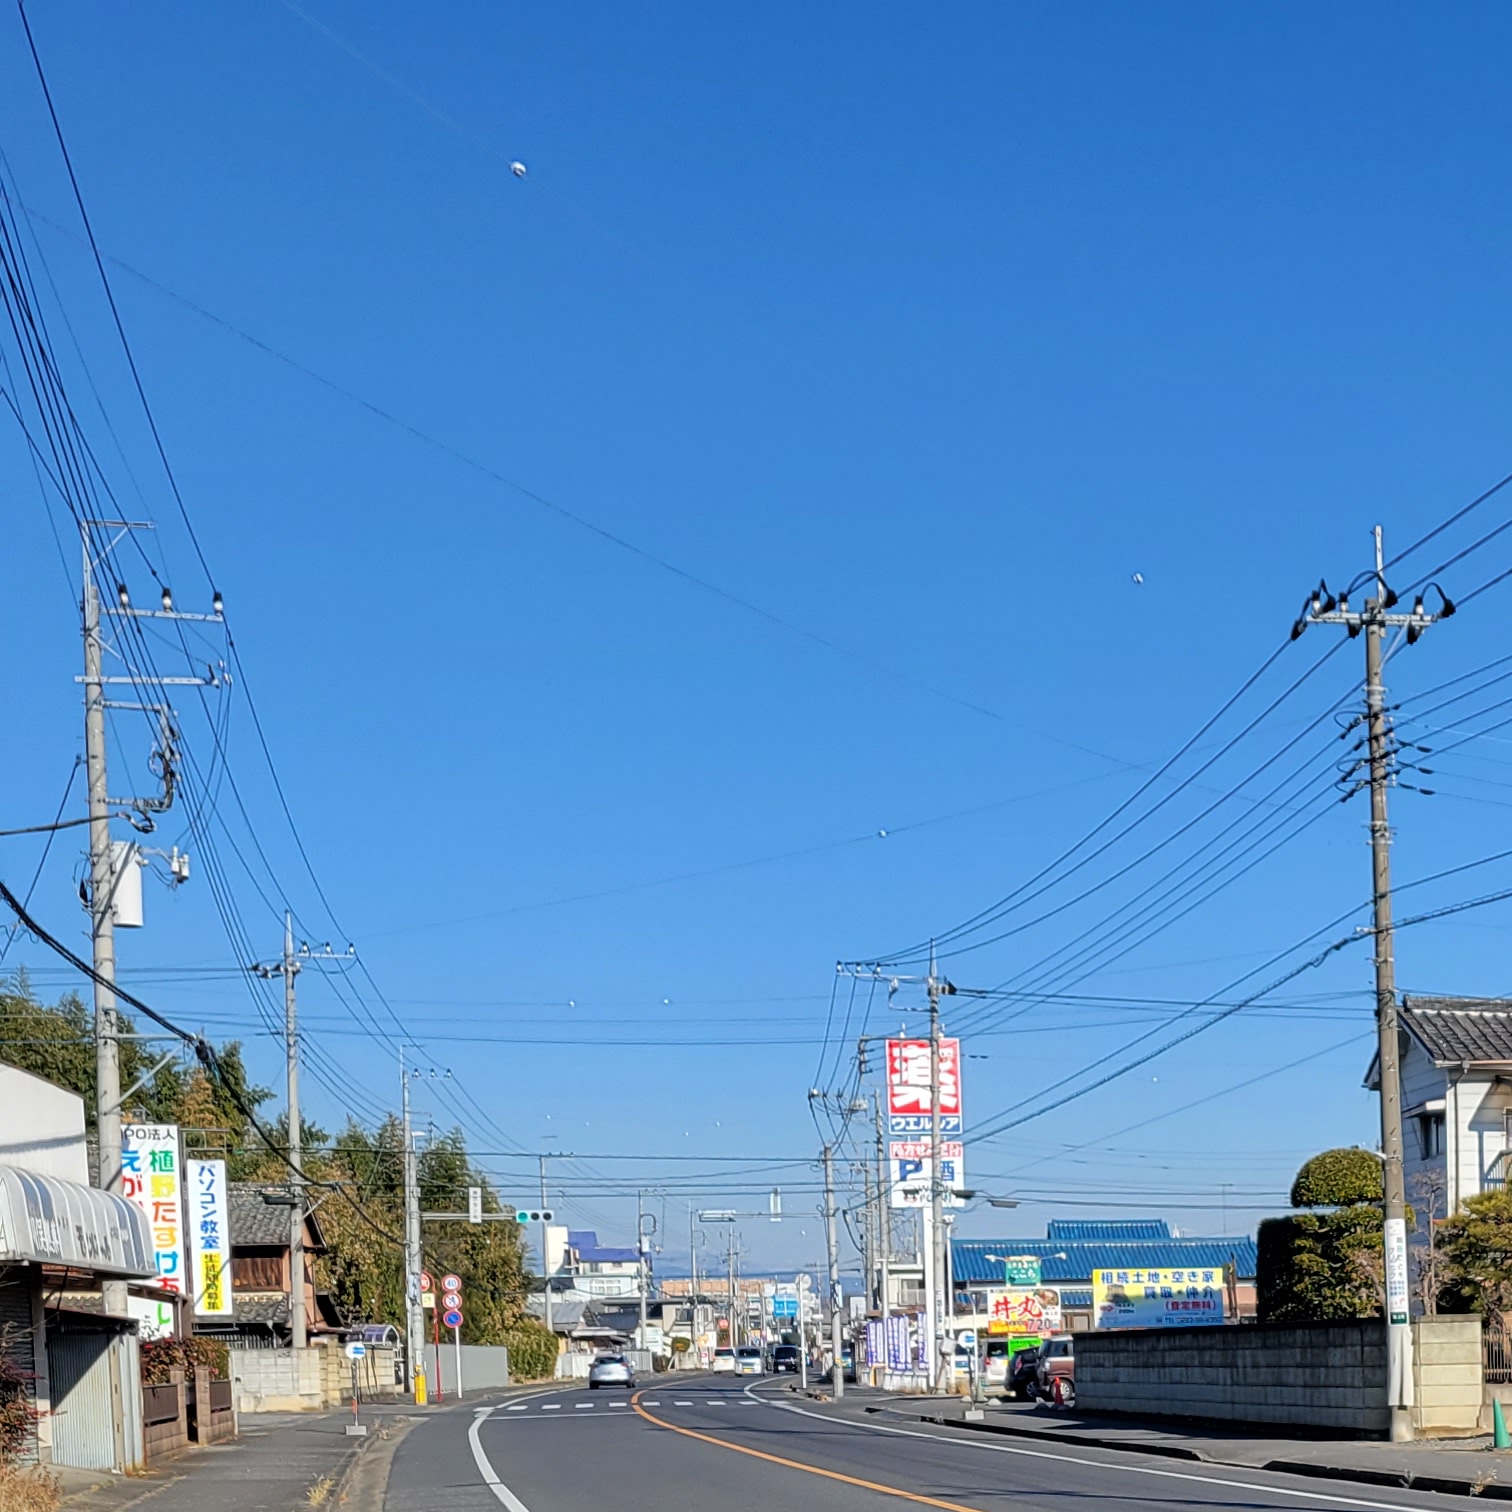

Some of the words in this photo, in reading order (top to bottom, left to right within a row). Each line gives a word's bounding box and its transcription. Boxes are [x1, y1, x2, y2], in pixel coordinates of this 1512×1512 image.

[891, 1044, 959, 1110] 薬
[121, 1128, 175, 1141] PO法人
[446, 1279, 458, 1288] 40
[1101, 1271, 1215, 1285] 相続土地・空き家
[1027, 1318, 1052, 1331] 720
